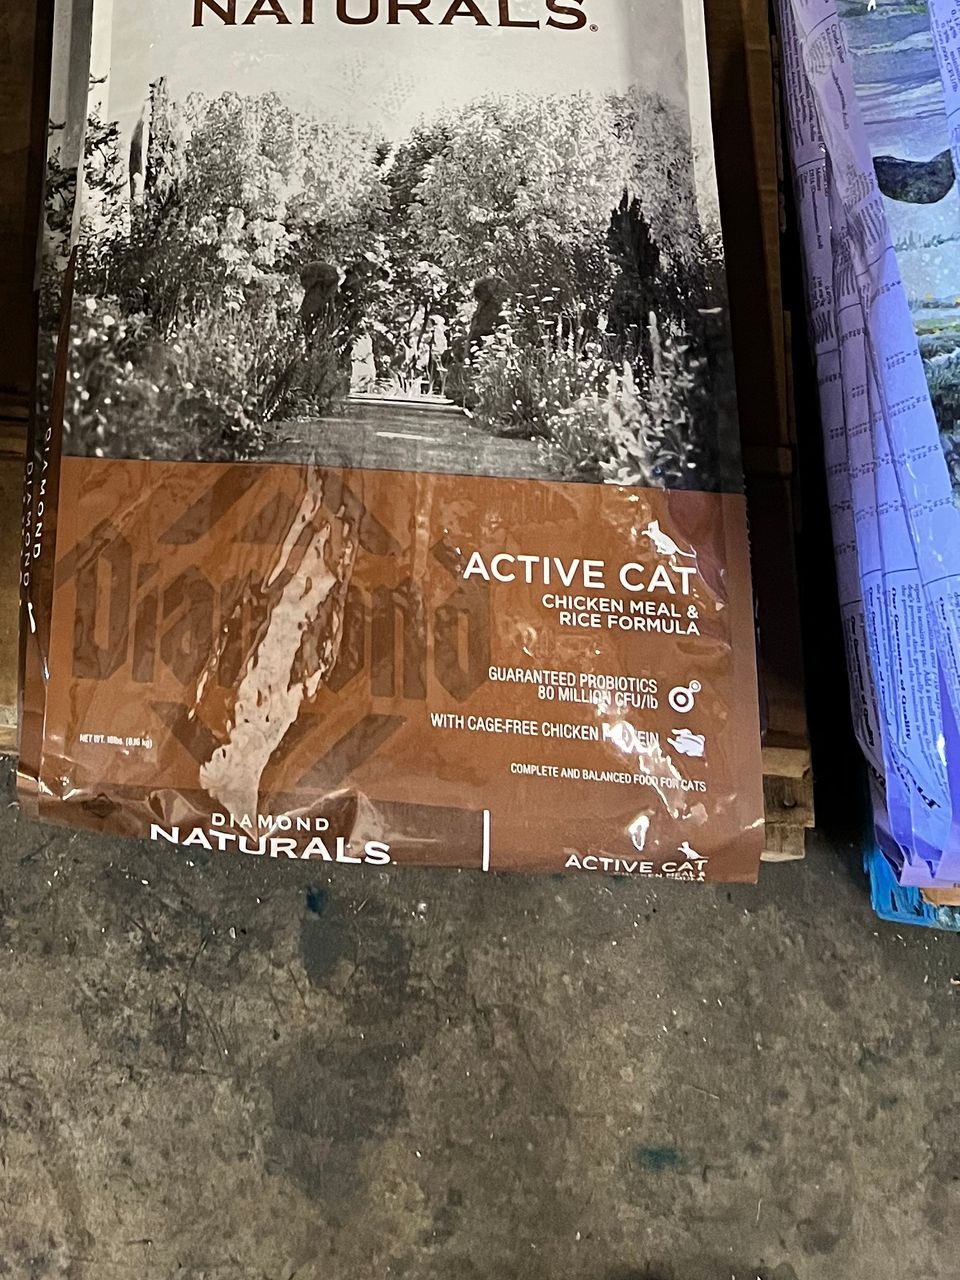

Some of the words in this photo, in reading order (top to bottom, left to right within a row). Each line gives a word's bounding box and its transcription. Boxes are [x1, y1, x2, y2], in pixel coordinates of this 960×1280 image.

[463, 551, 606, 590] ACTIVE
[619, 562, 697, 595] CAT
[542, 594, 626, 613] CHICKEN
[629, 600, 682, 617] MEAL
[686, 604, 699, 619] &
[559, 612, 602, 628] RICE
[608, 615, 700, 636] FORMULA
[488, 666, 576, 686] GUARANTEED
[580, 674, 658, 693] PROBIOTICS
[538, 685, 555, 699] 80
[558, 687, 611, 704] MILLION
[615, 691, 659, 709] CFU/lb
[430, 713, 465, 729] WITH
[467, 716, 538, 736] CAGE-FREE
[542, 721, 599, 741] CHICKEN
[510, 763, 559, 778] COMPLETE
[561, 767, 580, 780] AND
[582, 769, 632, 784] BALANCED
[633, 774, 658, 787] FOOD
[681, 779, 707, 792] CATS
[211, 812, 330, 832] DIAMOND
[150, 824, 391, 866] NATURALS
[565, 854, 654, 873] ACTIVE
[662, 860, 708, 872] CAT
